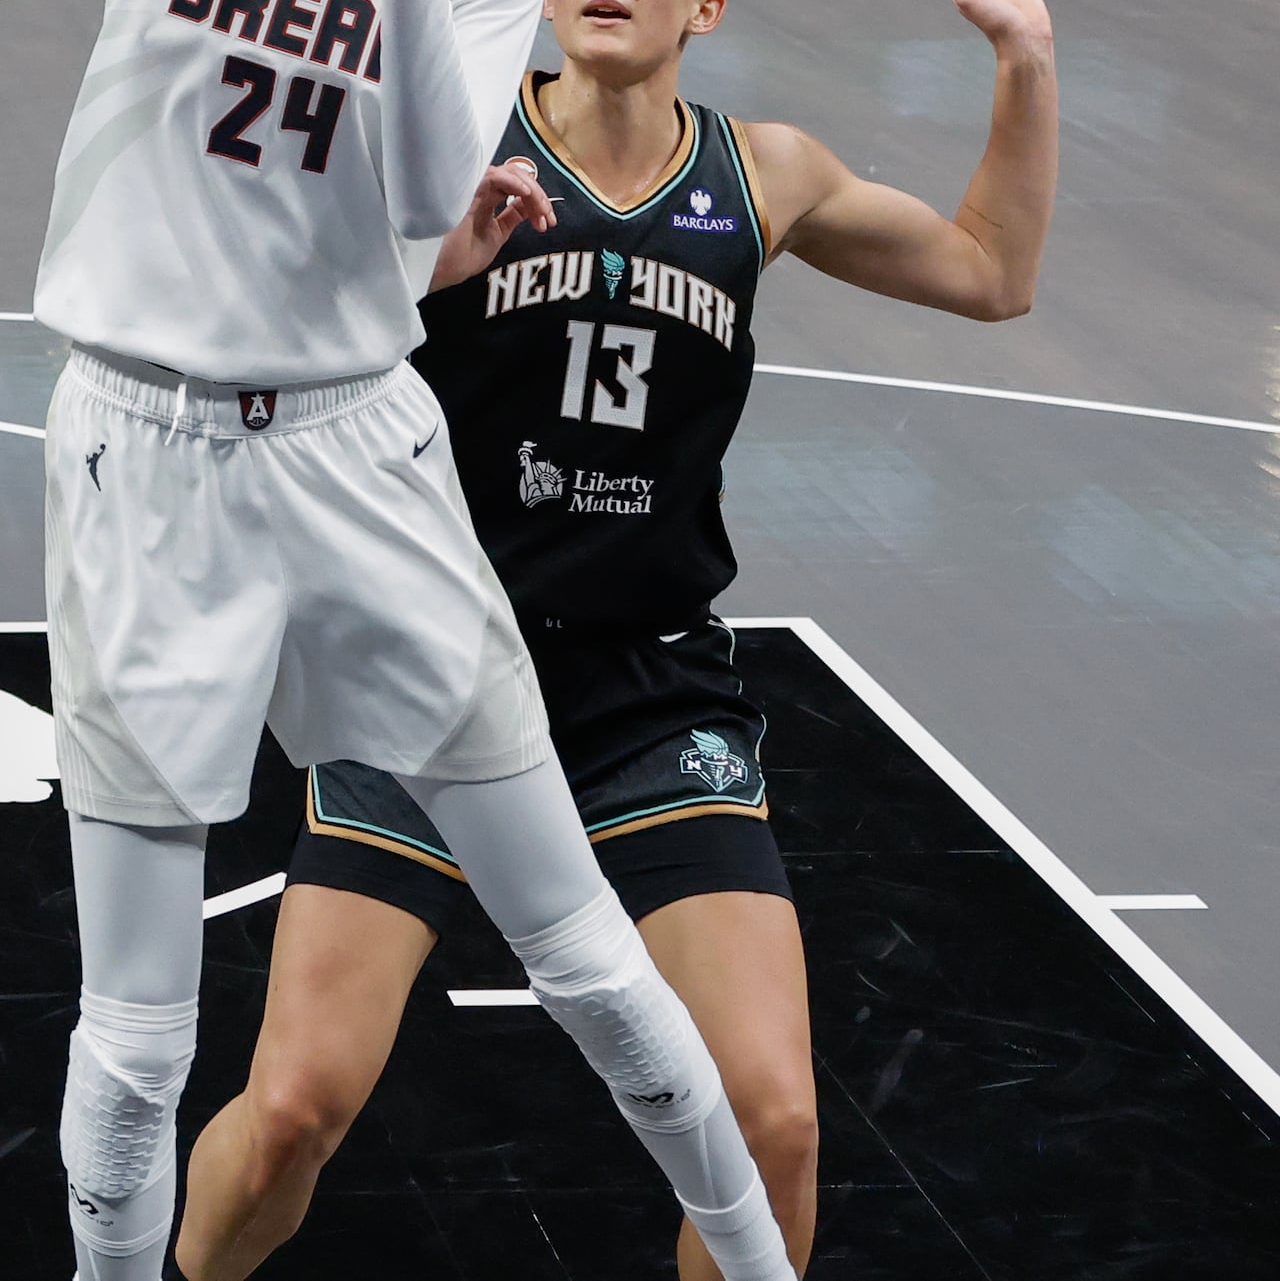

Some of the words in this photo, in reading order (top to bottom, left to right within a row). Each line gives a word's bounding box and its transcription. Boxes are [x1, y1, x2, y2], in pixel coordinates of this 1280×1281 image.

[206, 54, 347, 175] 24
[672, 214, 734, 231] BARCLAYS
[485, 251, 595, 319] NEW
[629, 255, 737, 353] YORK
[560, 319, 657, 432] 13
[567, 493, 652, 514] Mutual
[571, 469, 655, 501] Liberty
